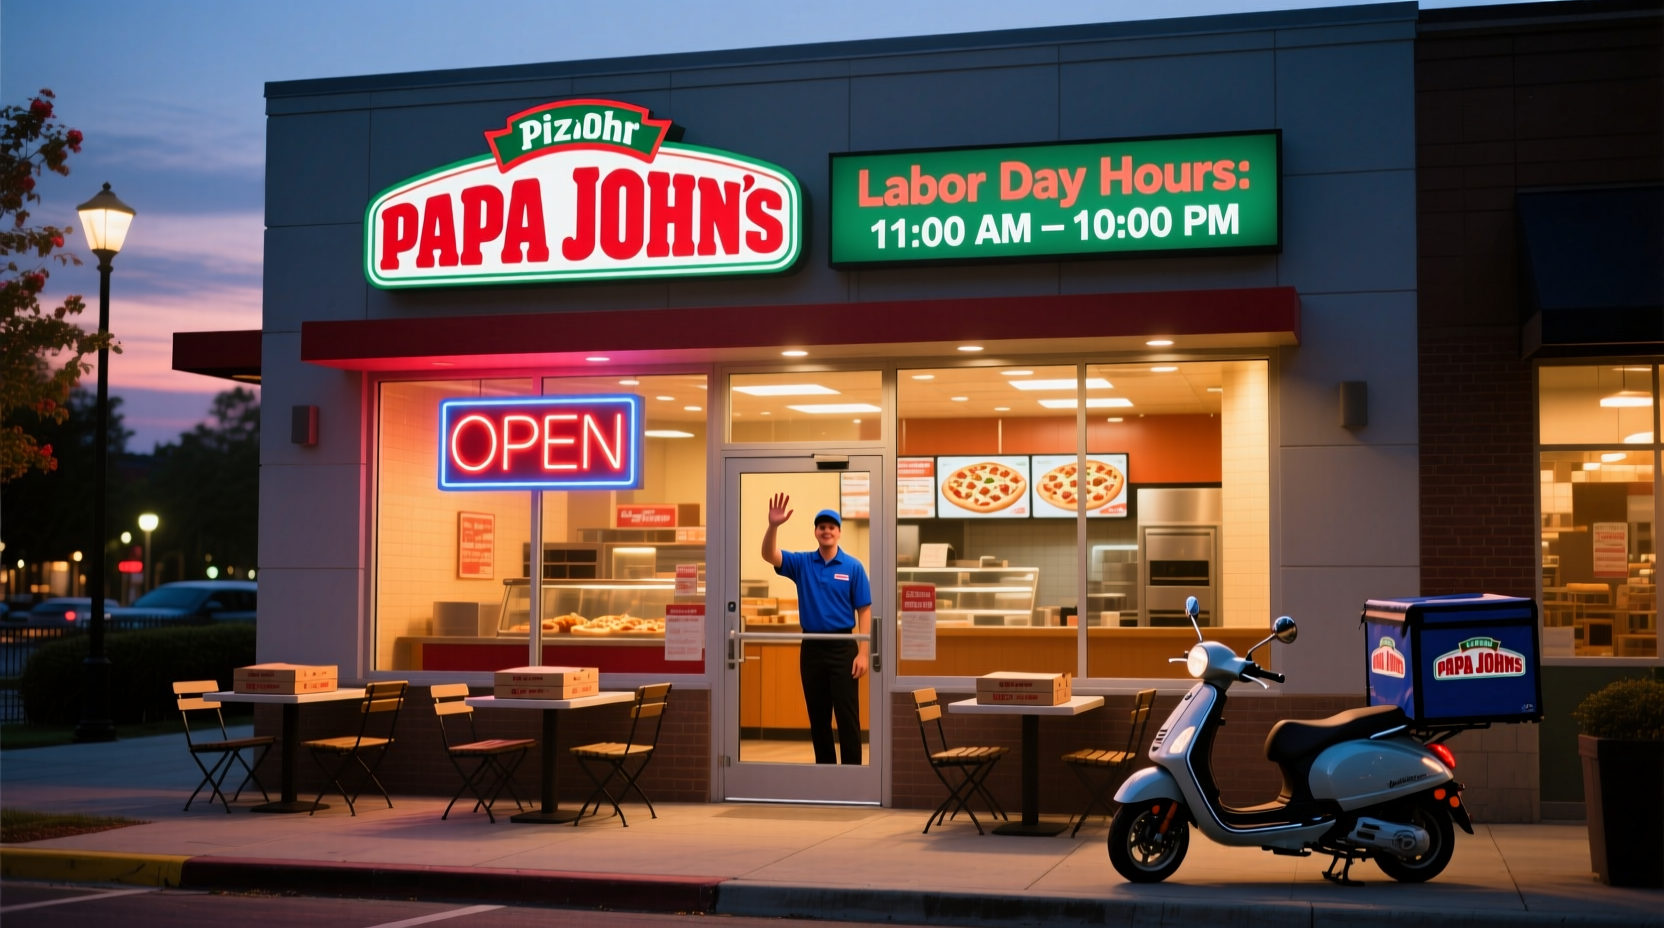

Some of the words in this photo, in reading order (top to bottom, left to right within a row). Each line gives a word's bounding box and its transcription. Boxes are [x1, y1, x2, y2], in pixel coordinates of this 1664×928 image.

[859, 165, 986, 207] Labor
[1000, 161, 1087, 208] Day
[1100, 156, 1250, 196] Hours:
[380, 178, 549, 270] PAPA
[562, 166, 784, 262] JOHN'S
[870, 215, 965, 249] 11:00
[975, 213, 1032, 245] AM
[1073, 205, 1173, 241] 10:00
[1184, 203, 1239, 236] PM
[452, 413, 621, 471] OPEN
[1438, 655, 1473, 677] PAPA
